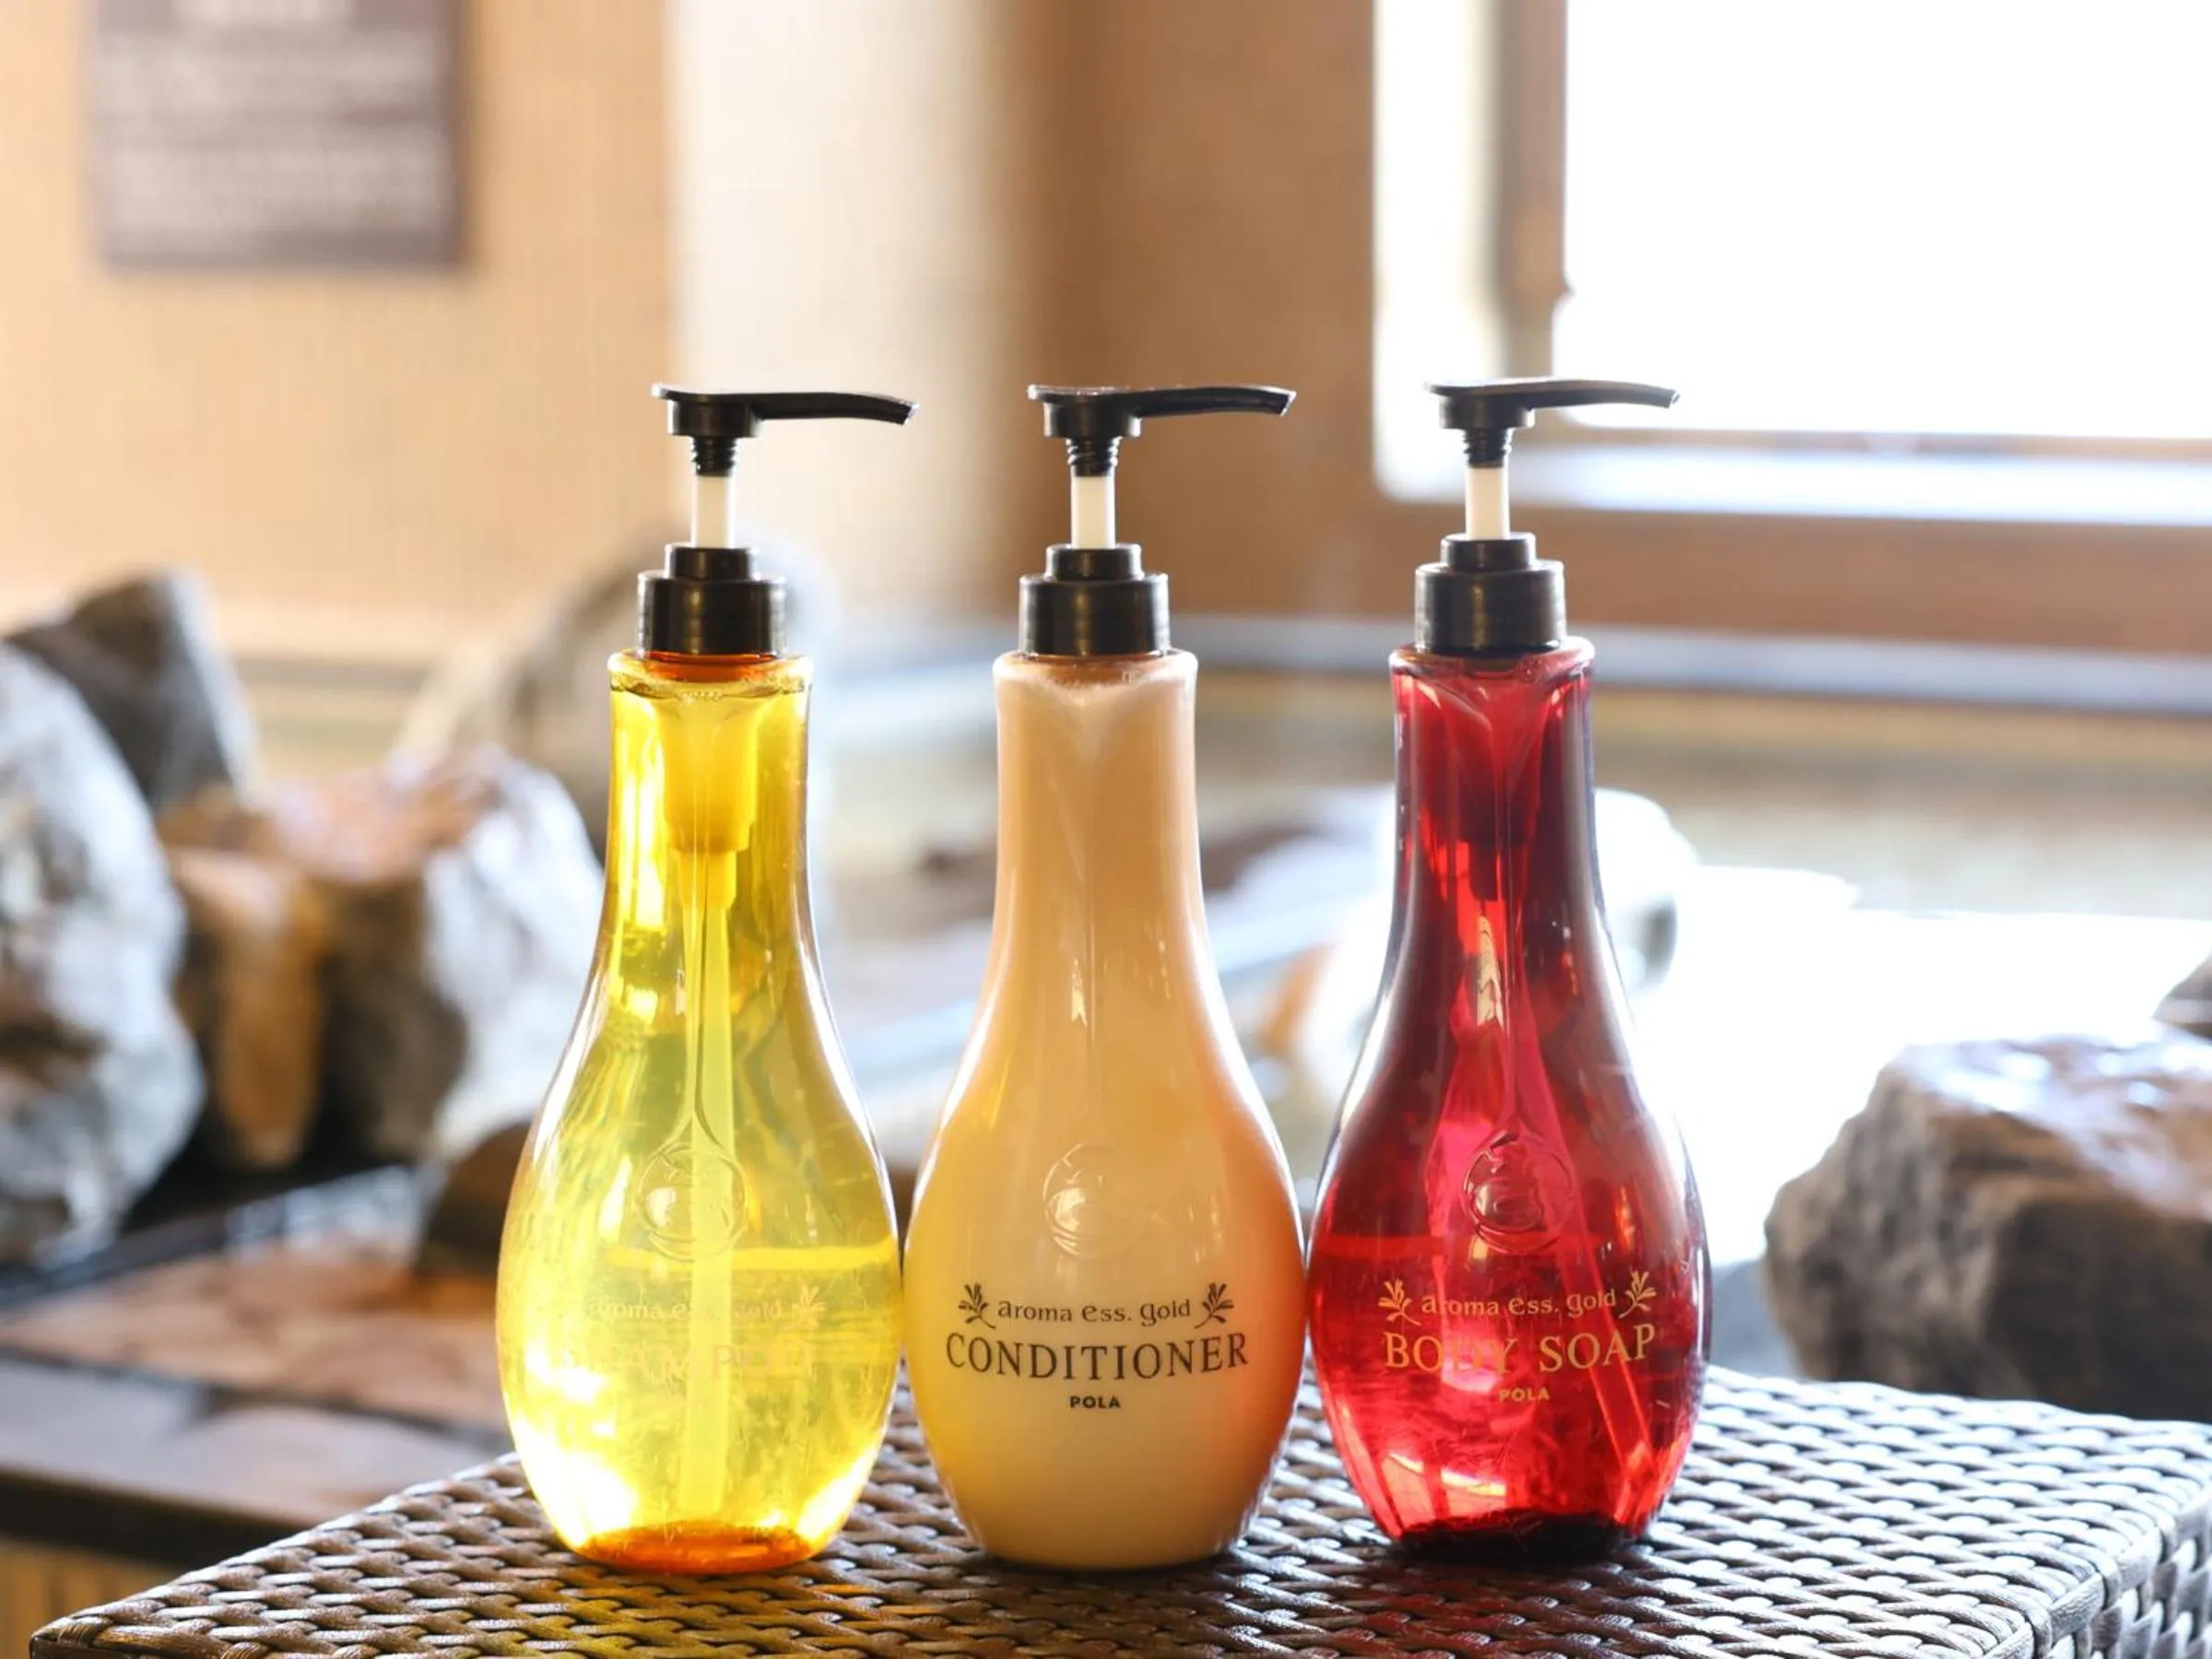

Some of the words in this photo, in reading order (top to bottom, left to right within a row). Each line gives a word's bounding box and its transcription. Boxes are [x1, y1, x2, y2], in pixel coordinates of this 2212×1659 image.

[997, 1300, 1073, 1323] aroma
[1081, 1304, 1133, 1324] ess.
[1139, 1299, 1192, 1327] gold
[1421, 1294, 1500, 1316] aroma
[1508, 1298, 1559, 1316] ess.
[1566, 1288, 1618, 1319] gold
[945, 1332, 1251, 1382] CONDITIONER
[1382, 1331, 1518, 1374] BODY
[1538, 1323, 1656, 1373] SOAP
[1069, 1394, 1122, 1410] POLA
[1499, 1388, 1551, 1403] POLA
